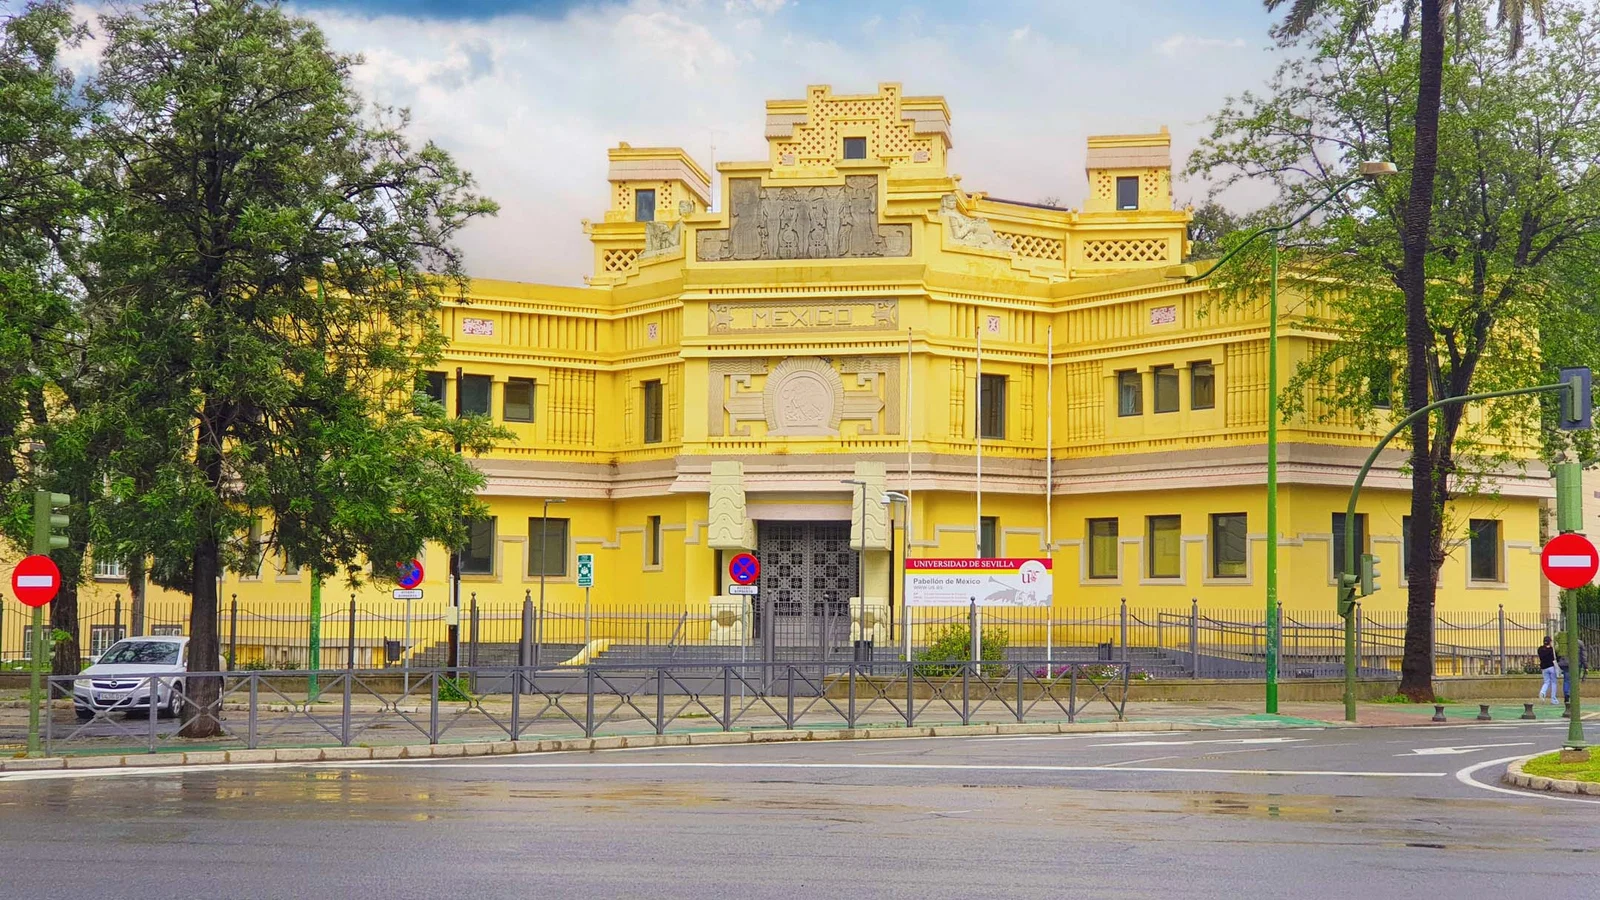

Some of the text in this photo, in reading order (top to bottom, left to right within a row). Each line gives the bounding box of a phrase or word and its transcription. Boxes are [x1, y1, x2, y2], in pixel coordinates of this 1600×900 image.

[752, 307, 852, 328] MEXICO
[913, 560, 1015, 568] UNIVERSIDAD DE SEVILLA
[913, 577, 944, 585] Pabellón
[956, 577, 981, 585] México
